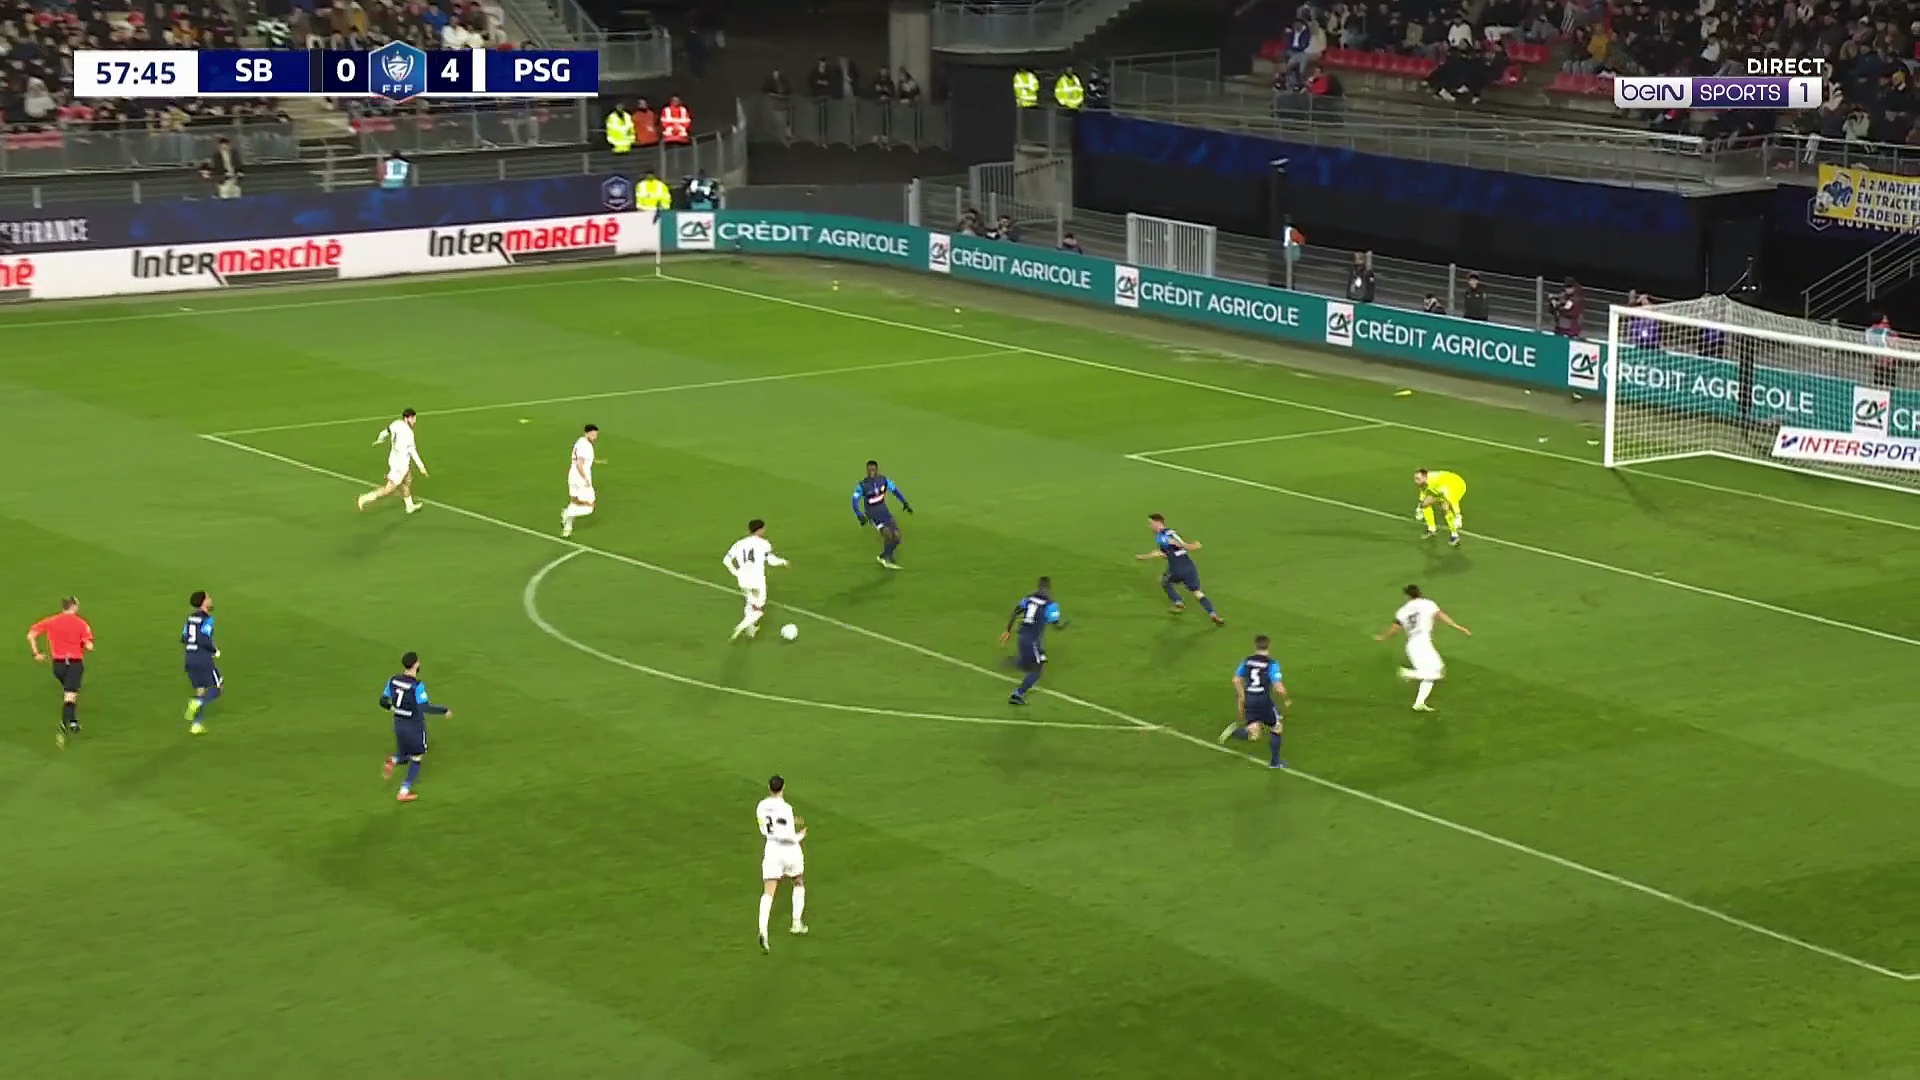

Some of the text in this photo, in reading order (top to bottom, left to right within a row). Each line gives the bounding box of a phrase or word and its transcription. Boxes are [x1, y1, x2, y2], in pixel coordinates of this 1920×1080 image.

[1855, 206, 1891, 222] STADE
[1893, 212, 1908, 225] DE
[1857, 191, 1920, 211] EN TRACTE
[427, 217, 620, 264] Intermarché
[717, 219, 814, 242] CRÉDIT
[817, 227, 909, 256] AGRICOLE
[131, 239, 343, 287] Intermarché
[951, 245, 1007, 273] CRÉDIT
[1010, 260, 1093, 290] AGRICOLE
[1140, 281, 1204, 309] CRÉDIT
[1207, 295, 1300, 327] AGRICOLE
[1356, 319, 1427, 349] CRÉDIT
[1431, 332, 1537, 368] AGRICOLE
[1691, 376, 1814, 415] AGRCOLE
[1798, 435, 1920, 462] INTERSPOR
[742, 547, 755, 564] 14
[1250, 668, 1261, 687] 5
[765, 815, 774, 835] 2
